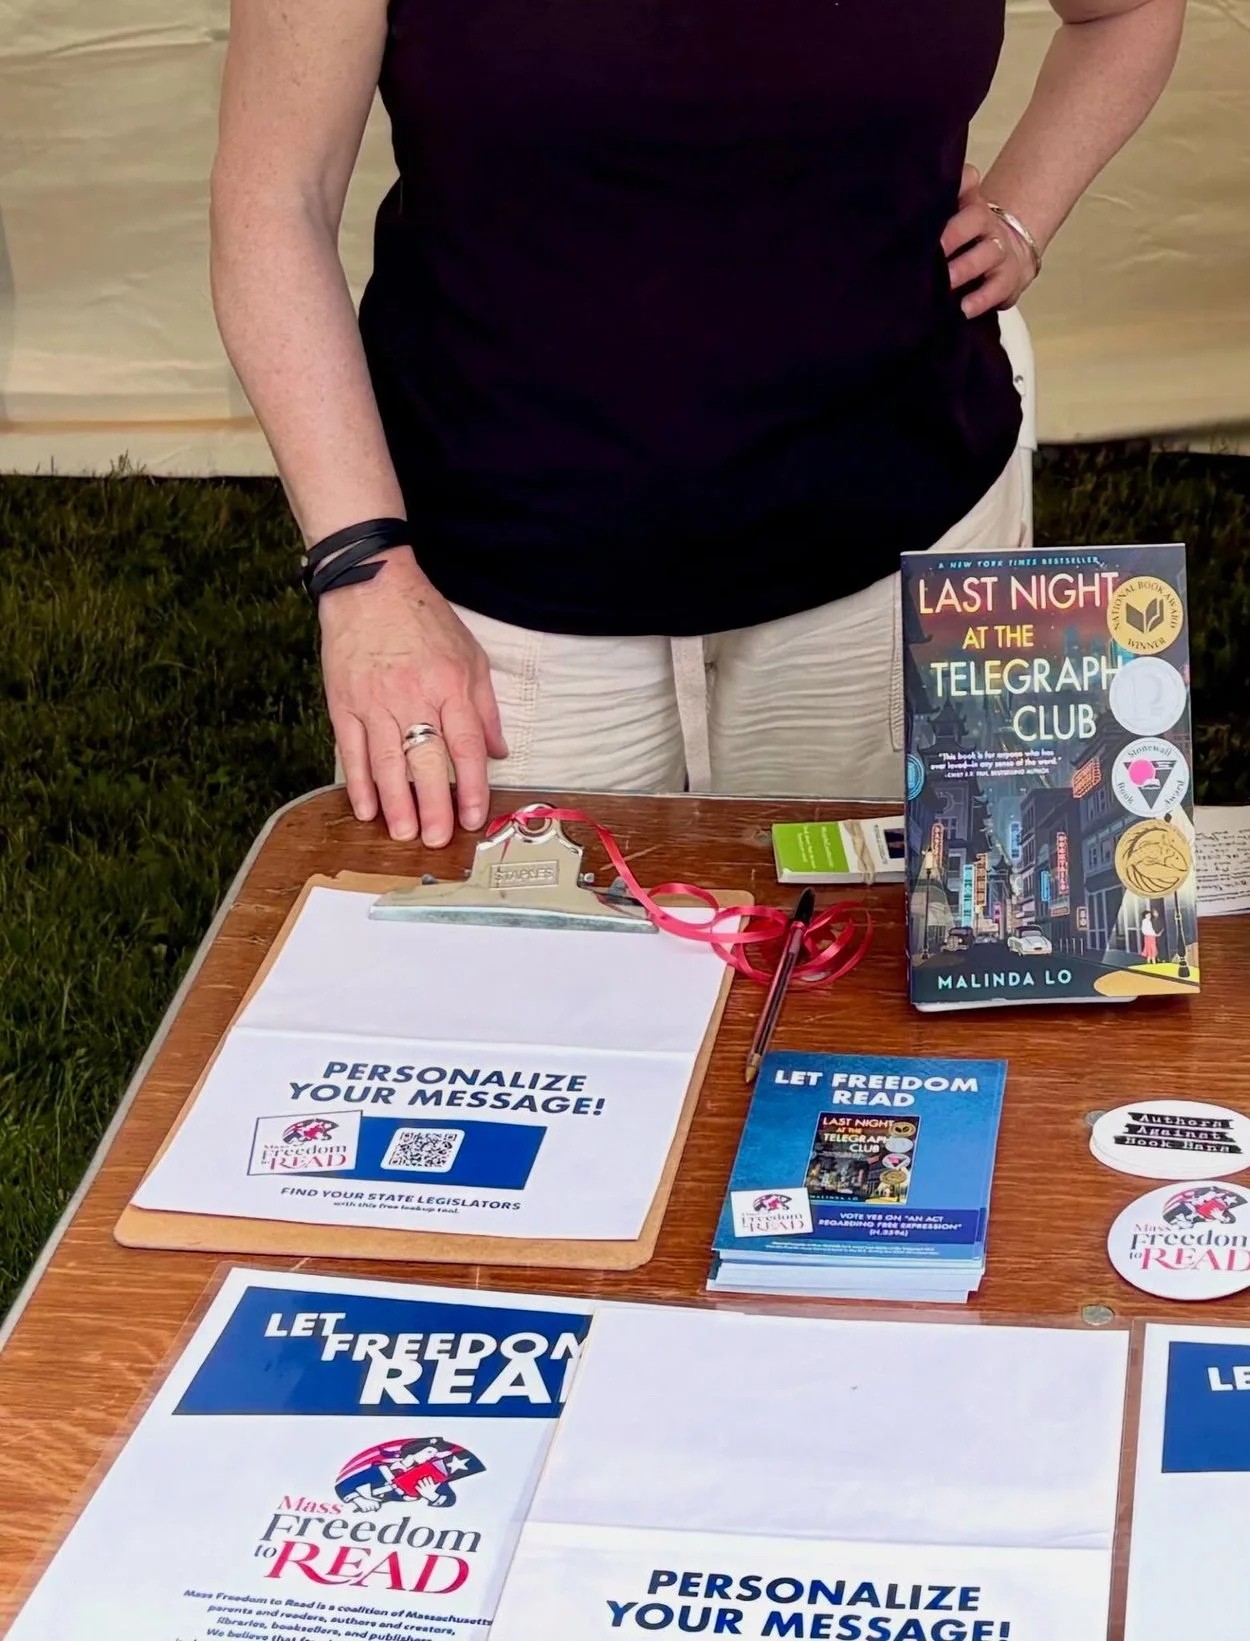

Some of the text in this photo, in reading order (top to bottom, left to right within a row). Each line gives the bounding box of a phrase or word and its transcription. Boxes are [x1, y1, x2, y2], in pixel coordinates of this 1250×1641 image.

[977, 560, 1003, 568] YORK
[1008, 559, 1037, 567] TIMES
[1041, 556, 1099, 566] BESTSELLER
[919, 571, 1119, 614] LAST NIGHT
[1137, 581, 1164, 594] BOOK
[962, 624, 1034, 650] AT THE
[1127, 637, 1166, 649] WINNER
[930, 655, 1123, 698] TELEGRAPH
[1013, 703, 1097, 742] CLUB
[938, 968, 1073, 990] MALINDA LO
[322, 1061, 588, 1093] PERSONALIZE
[775, 1070, 979, 1092] LET FREEDOM
[288, 1082, 606, 1117] YOUR MESSAGE!
[832, 1089, 916, 1107] READ
[823, 1117, 895, 1128] LAST NIGHT
[1139, 1113, 1223, 1128] Authors
[1137, 1125, 1222, 1141] Against
[262, 1145, 347, 1160] Freedom
[850, 1143, 880, 1153] CLUB
[1124, 1137, 1231, 1153] Book Bans
[281, 1187, 522, 1210] FIND YOUR STATE LEGISLATORS
[1134, 1223, 1172, 1233] Mass
[265, 1312, 347, 1338] LET
[277, 1495, 344, 1515] Mass
[258, 1512, 482, 1553] Freedom
[254, 1539, 470, 1595] to READ
[647, 1569, 981, 1612] PERSONALIZE
[605, 1600, 1012, 1641] YOUR MESSAGE!
